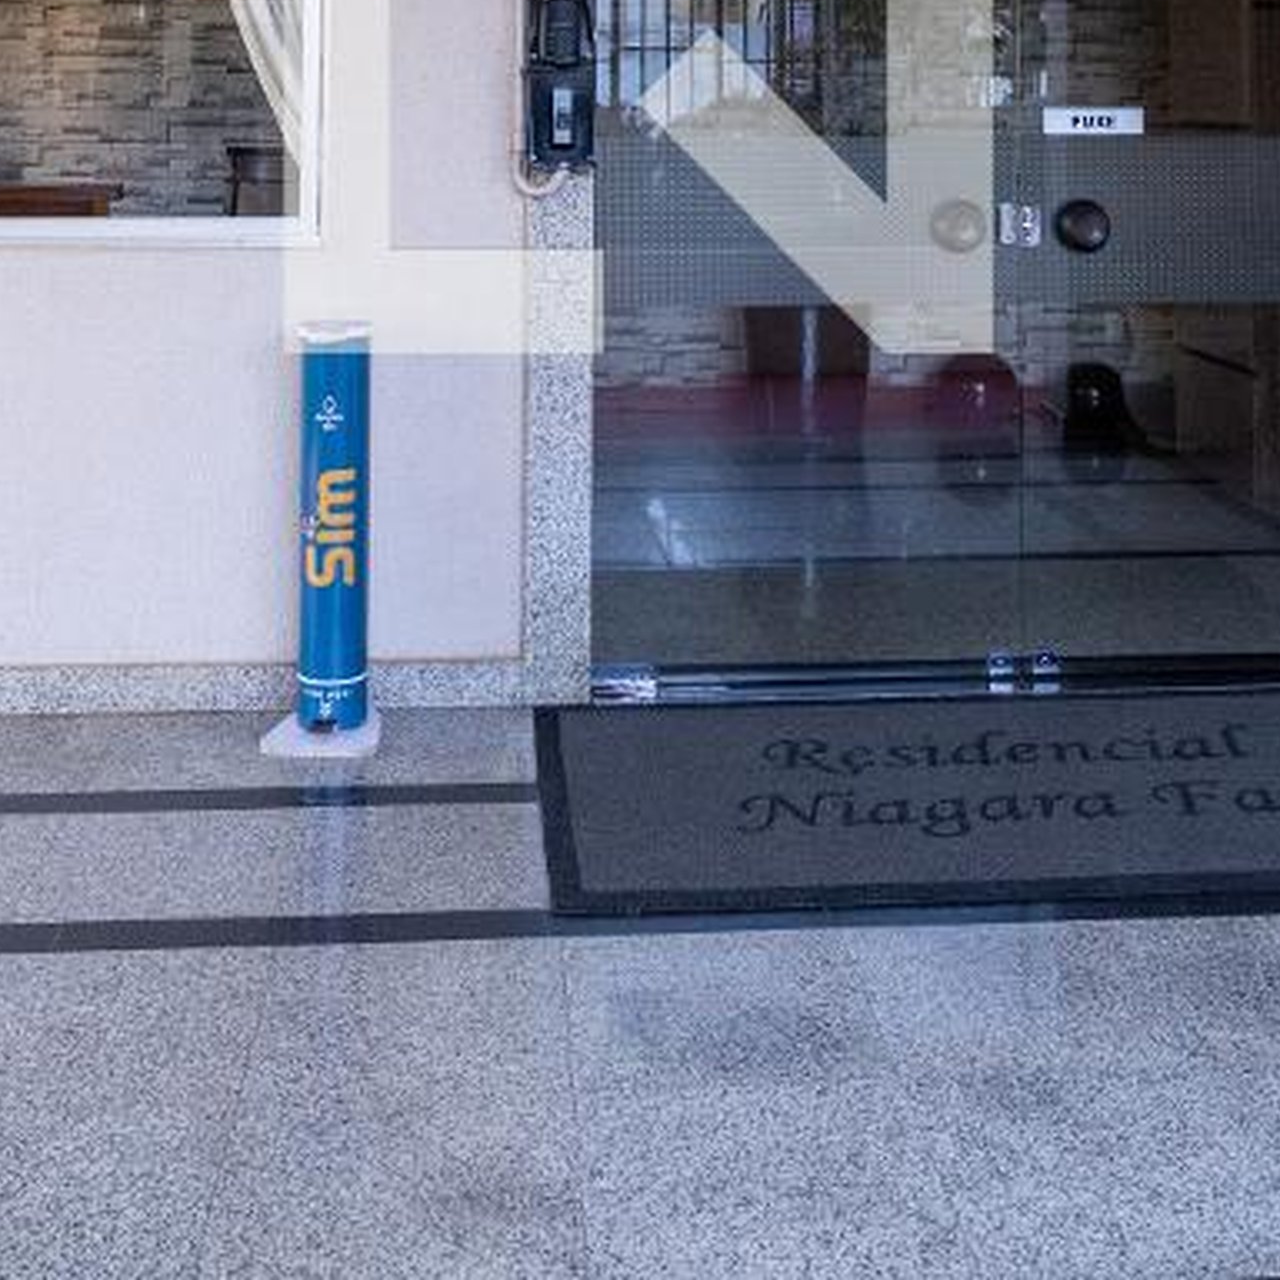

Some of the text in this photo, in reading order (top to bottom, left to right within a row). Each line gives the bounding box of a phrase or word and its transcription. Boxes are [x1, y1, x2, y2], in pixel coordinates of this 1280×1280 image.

[305, 468, 356, 589] Sim
[762, 722, 1249, 775] Residencial
[736, 790, 1122, 838] Niagara
